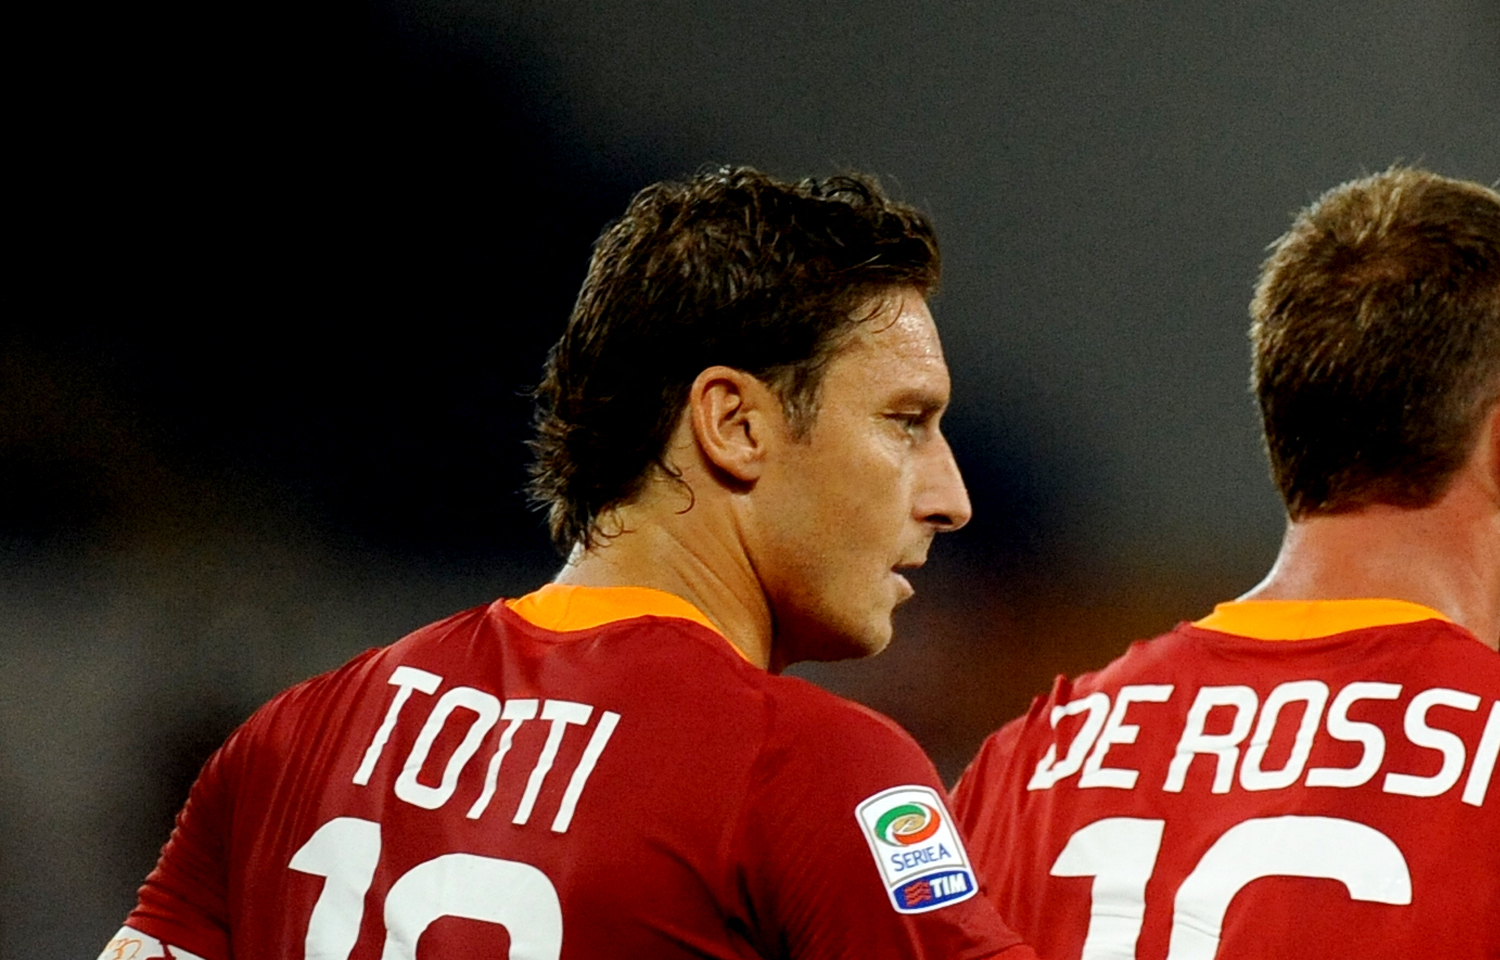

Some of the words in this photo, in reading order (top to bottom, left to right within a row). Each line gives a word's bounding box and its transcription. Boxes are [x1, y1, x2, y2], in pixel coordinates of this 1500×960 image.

[353, 666, 620, 833] TOTTI
[1027, 684, 1175, 791] DE
[929, 872, 968, 898] TIM
